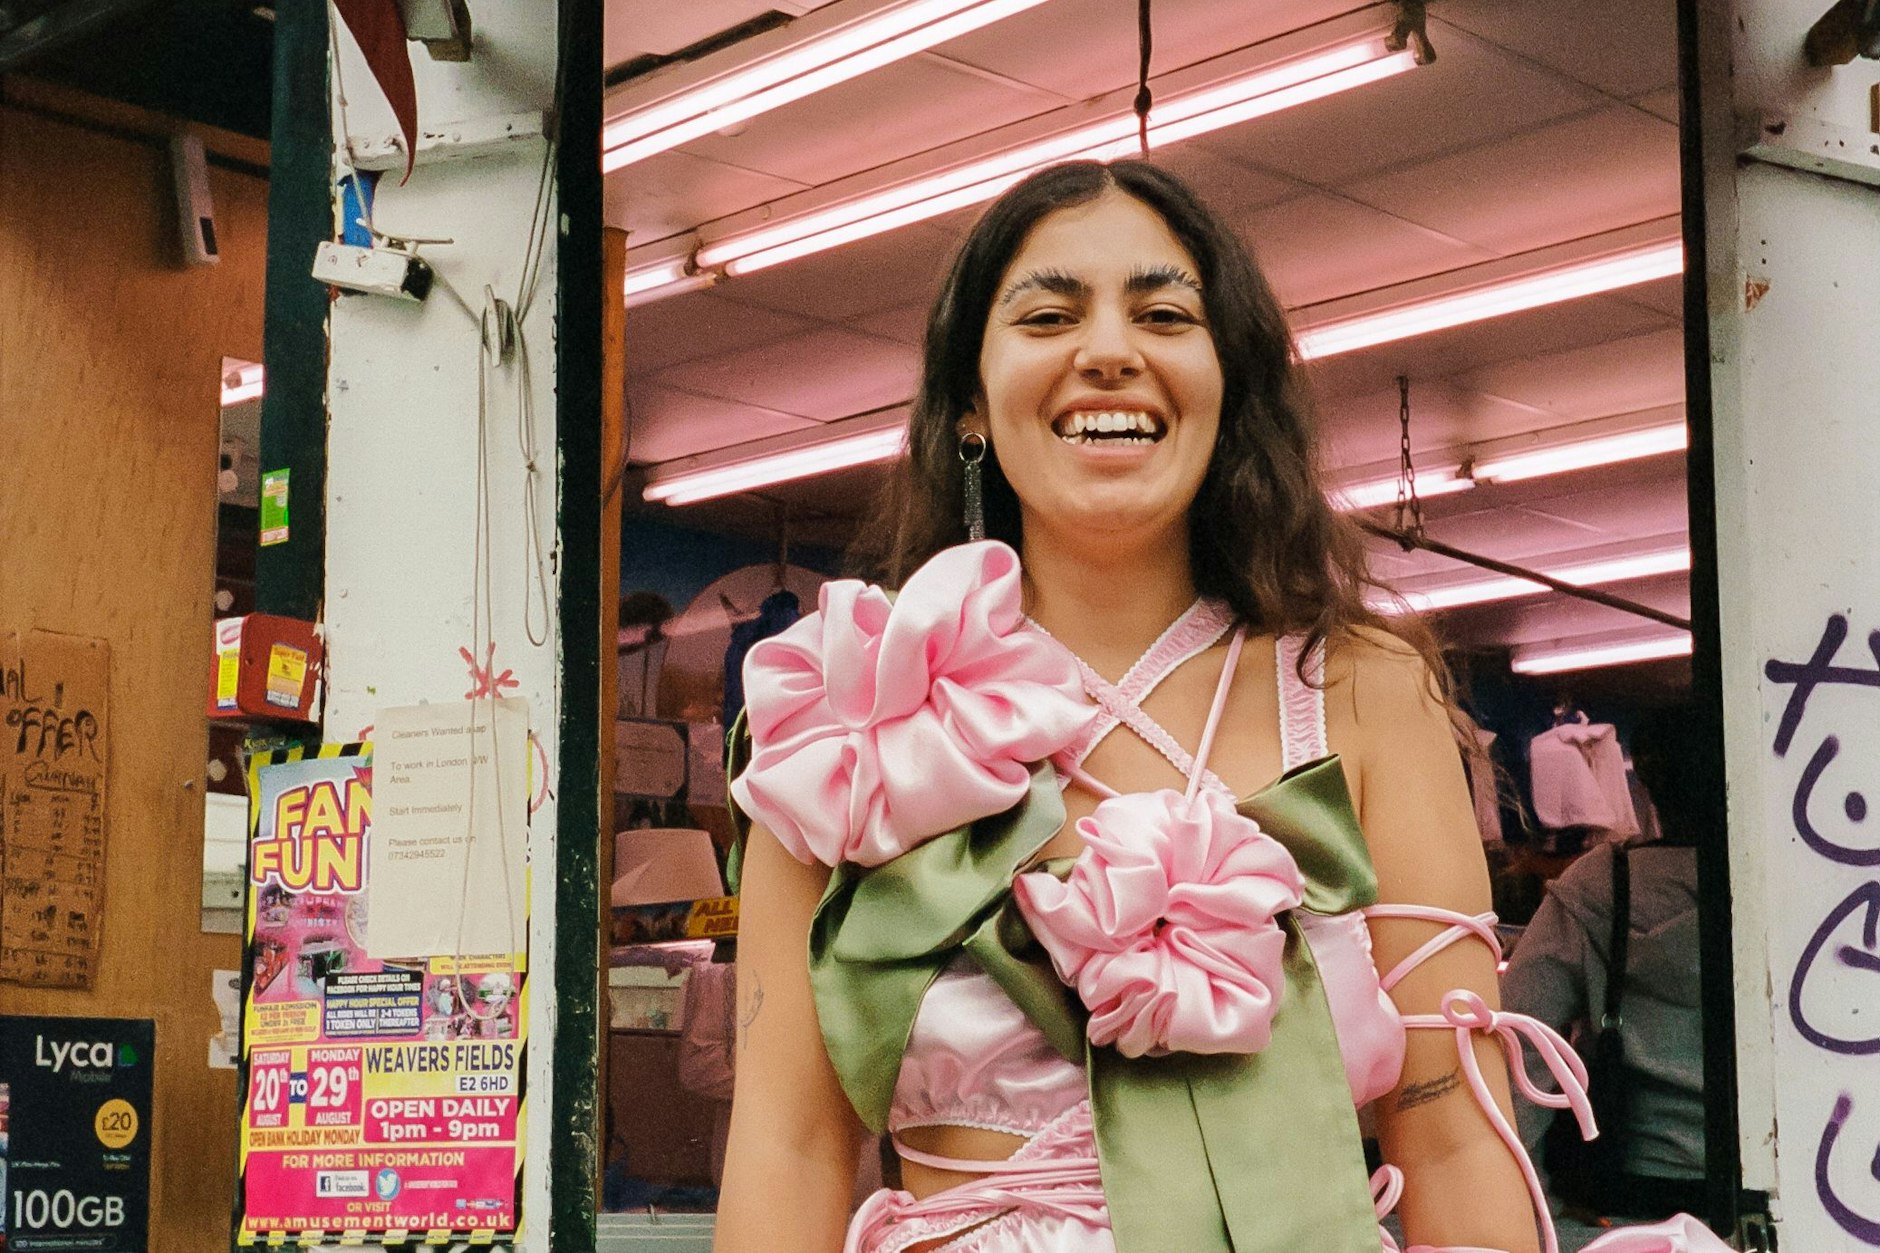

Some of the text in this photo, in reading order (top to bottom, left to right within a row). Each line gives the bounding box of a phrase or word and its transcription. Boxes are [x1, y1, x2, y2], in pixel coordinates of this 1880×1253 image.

[6, 706, 102, 763] OFFER
[392, 730, 428, 739] Cleaners
[432, 726, 464, 736] Wanted
[391, 761, 401, 770] To
[404, 762, 422, 770] work
[426, 760, 434, 768] in
[436, 758, 468, 768] London
[390, 803, 462, 816] Start Immediately
[388, 838, 417, 846] Please
[420, 836, 450, 845] contact
[453, 836, 462, 844] us
[252, 836, 362, 890] FUN
[694, 901, 733, 917] ALL
[338, 974, 410, 985] PLEASE CHECK DETAILS ON
[326, 982, 421, 994] FACEBOOK FOR HAPPY HOUR TIMES
[280, 1002, 317, 1010] ADMISSION
[326, 996, 420, 1009] HAPPY HOUR SPECIAL OFFER
[326, 1010, 336, 1019] ALL
[354, 1009, 368, 1018] WILL
[392, 1008, 418, 1017] TOKENS
[330, 1020, 355, 1030] TOKEN
[356, 1019, 376, 1030] ONLY
[380, 1018, 420, 1027] THEREAFTER
[36, 1034, 114, 1073] Lyca
[254, 1052, 290, 1066] SATURDAY
[311, 1048, 360, 1062] MONDAY
[366, 1044, 514, 1074] WEAVERS FIELDS
[254, 1068, 288, 1110] 20th
[290, 1079, 308, 1096] TO
[310, 1066, 360, 1106] 29th
[460, 1076, 508, 1091] E2 6HD
[371, 1098, 510, 1119] OPEN DAILY
[102, 1112, 132, 1131] £20
[256, 1113, 282, 1126] AUGUST
[315, 1111, 352, 1125] AUGUST
[250, 1129, 360, 1146] OPEN BANK HOLIDAY MONDAY
[380, 1120, 427, 1142] 1pm
[448, 1119, 500, 1141] 9pm
[282, 1152, 464, 1168] FOR MORE INFORMATION
[14, 1189, 125, 1229] 100GB
[347, 1202, 392, 1212] OR VISIT
[248, 1212, 510, 1229] www.amusementworld.co.uk
